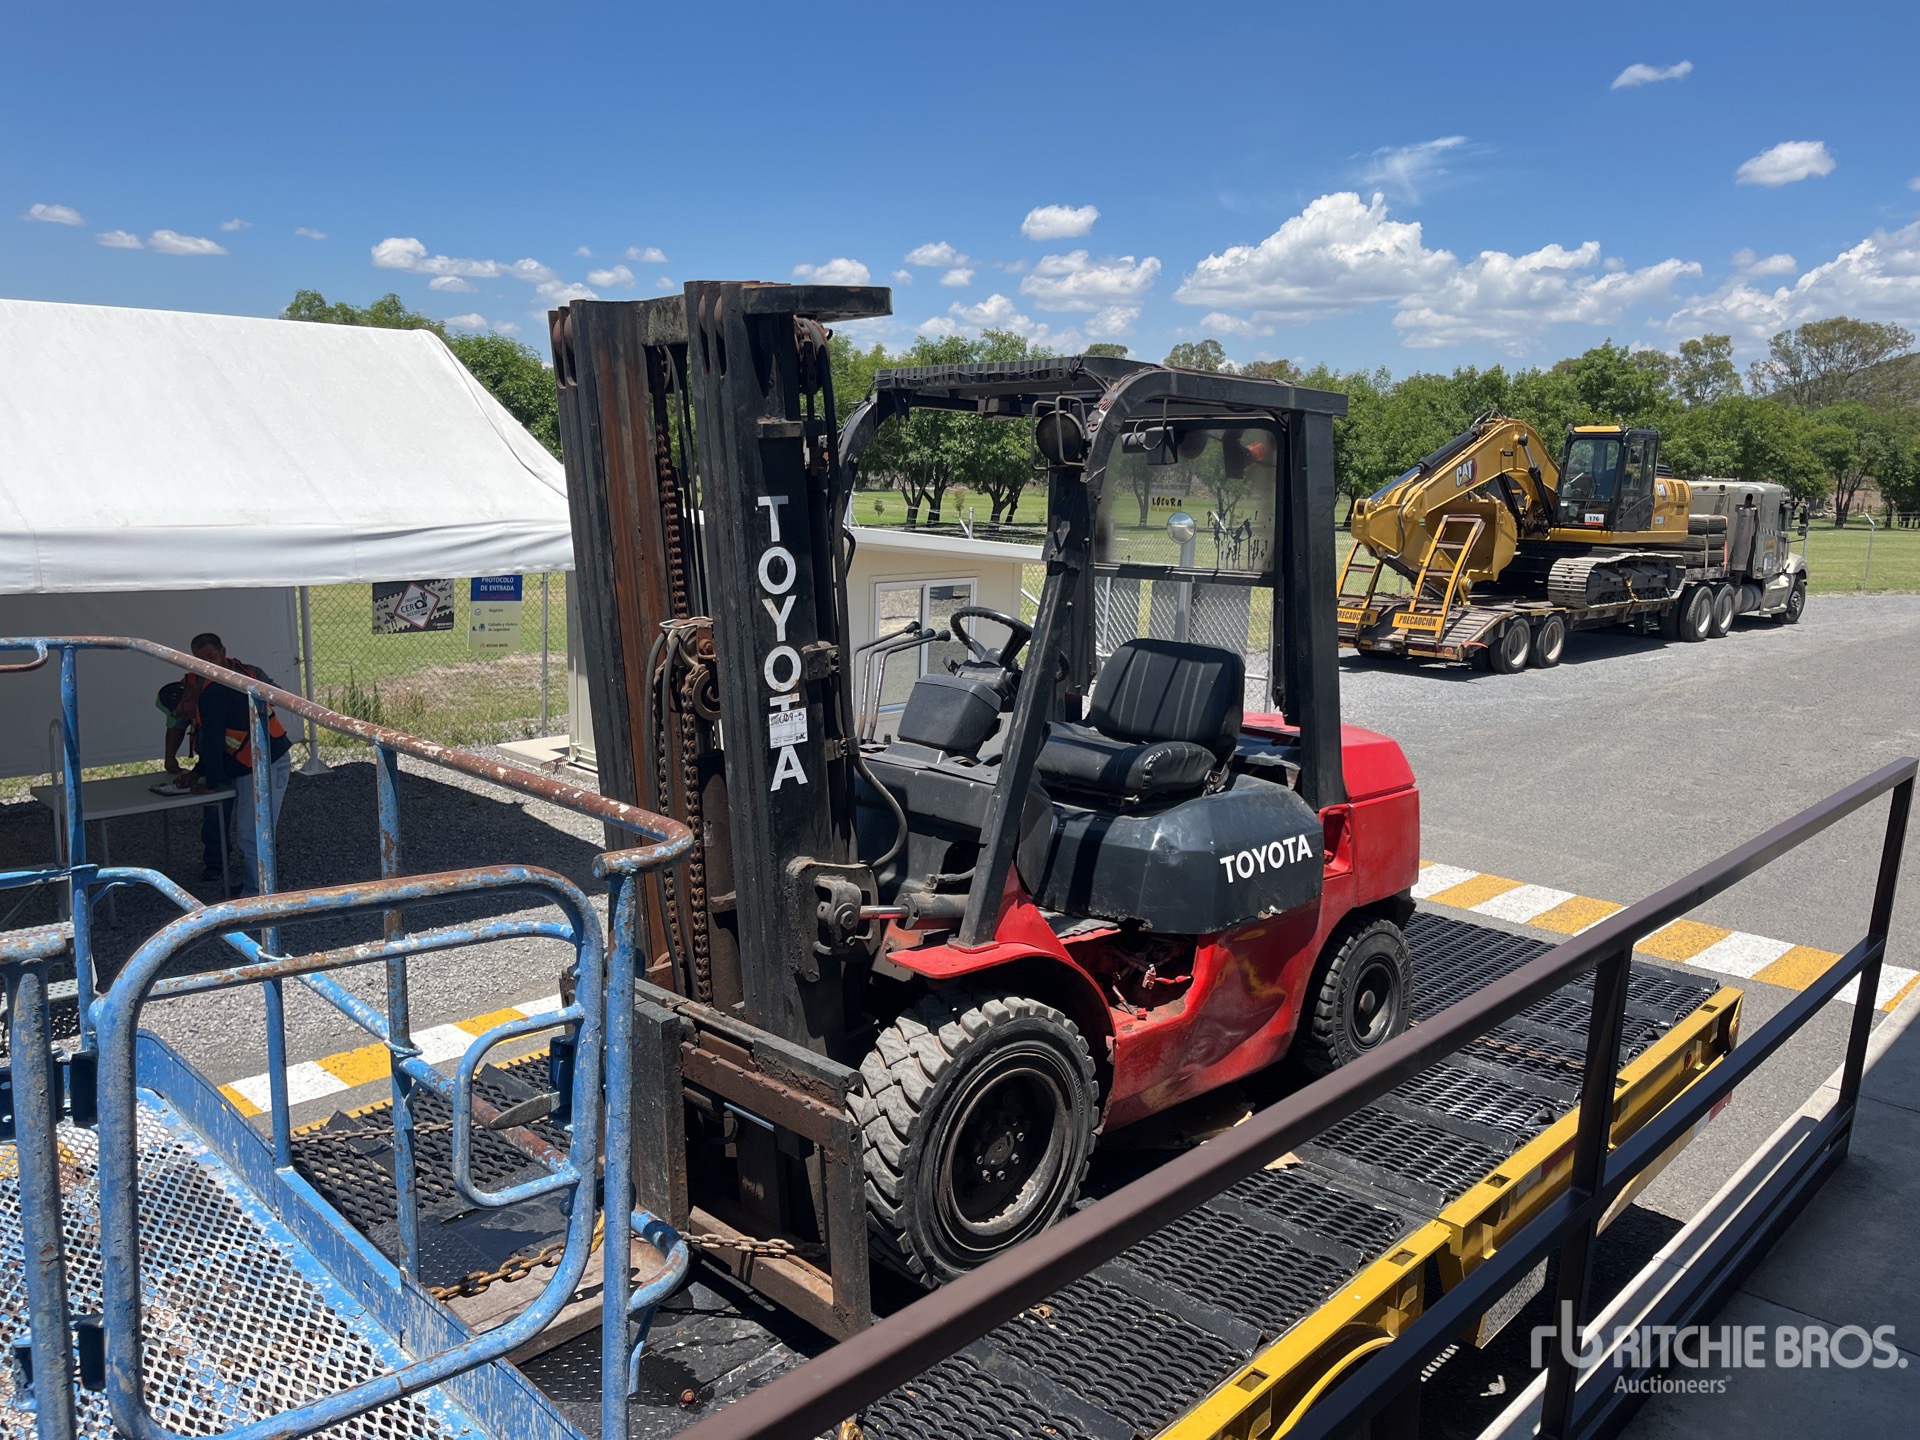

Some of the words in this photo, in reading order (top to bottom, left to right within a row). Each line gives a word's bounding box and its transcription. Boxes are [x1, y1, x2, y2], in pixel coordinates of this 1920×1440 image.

[1456, 460, 1473, 487] CAT
[1338, 610, 1372, 622] RECAUCIÓN
[1398, 614, 1438, 627] PRECAUCIÓN
[1220, 834, 1314, 884] TOYOTA
